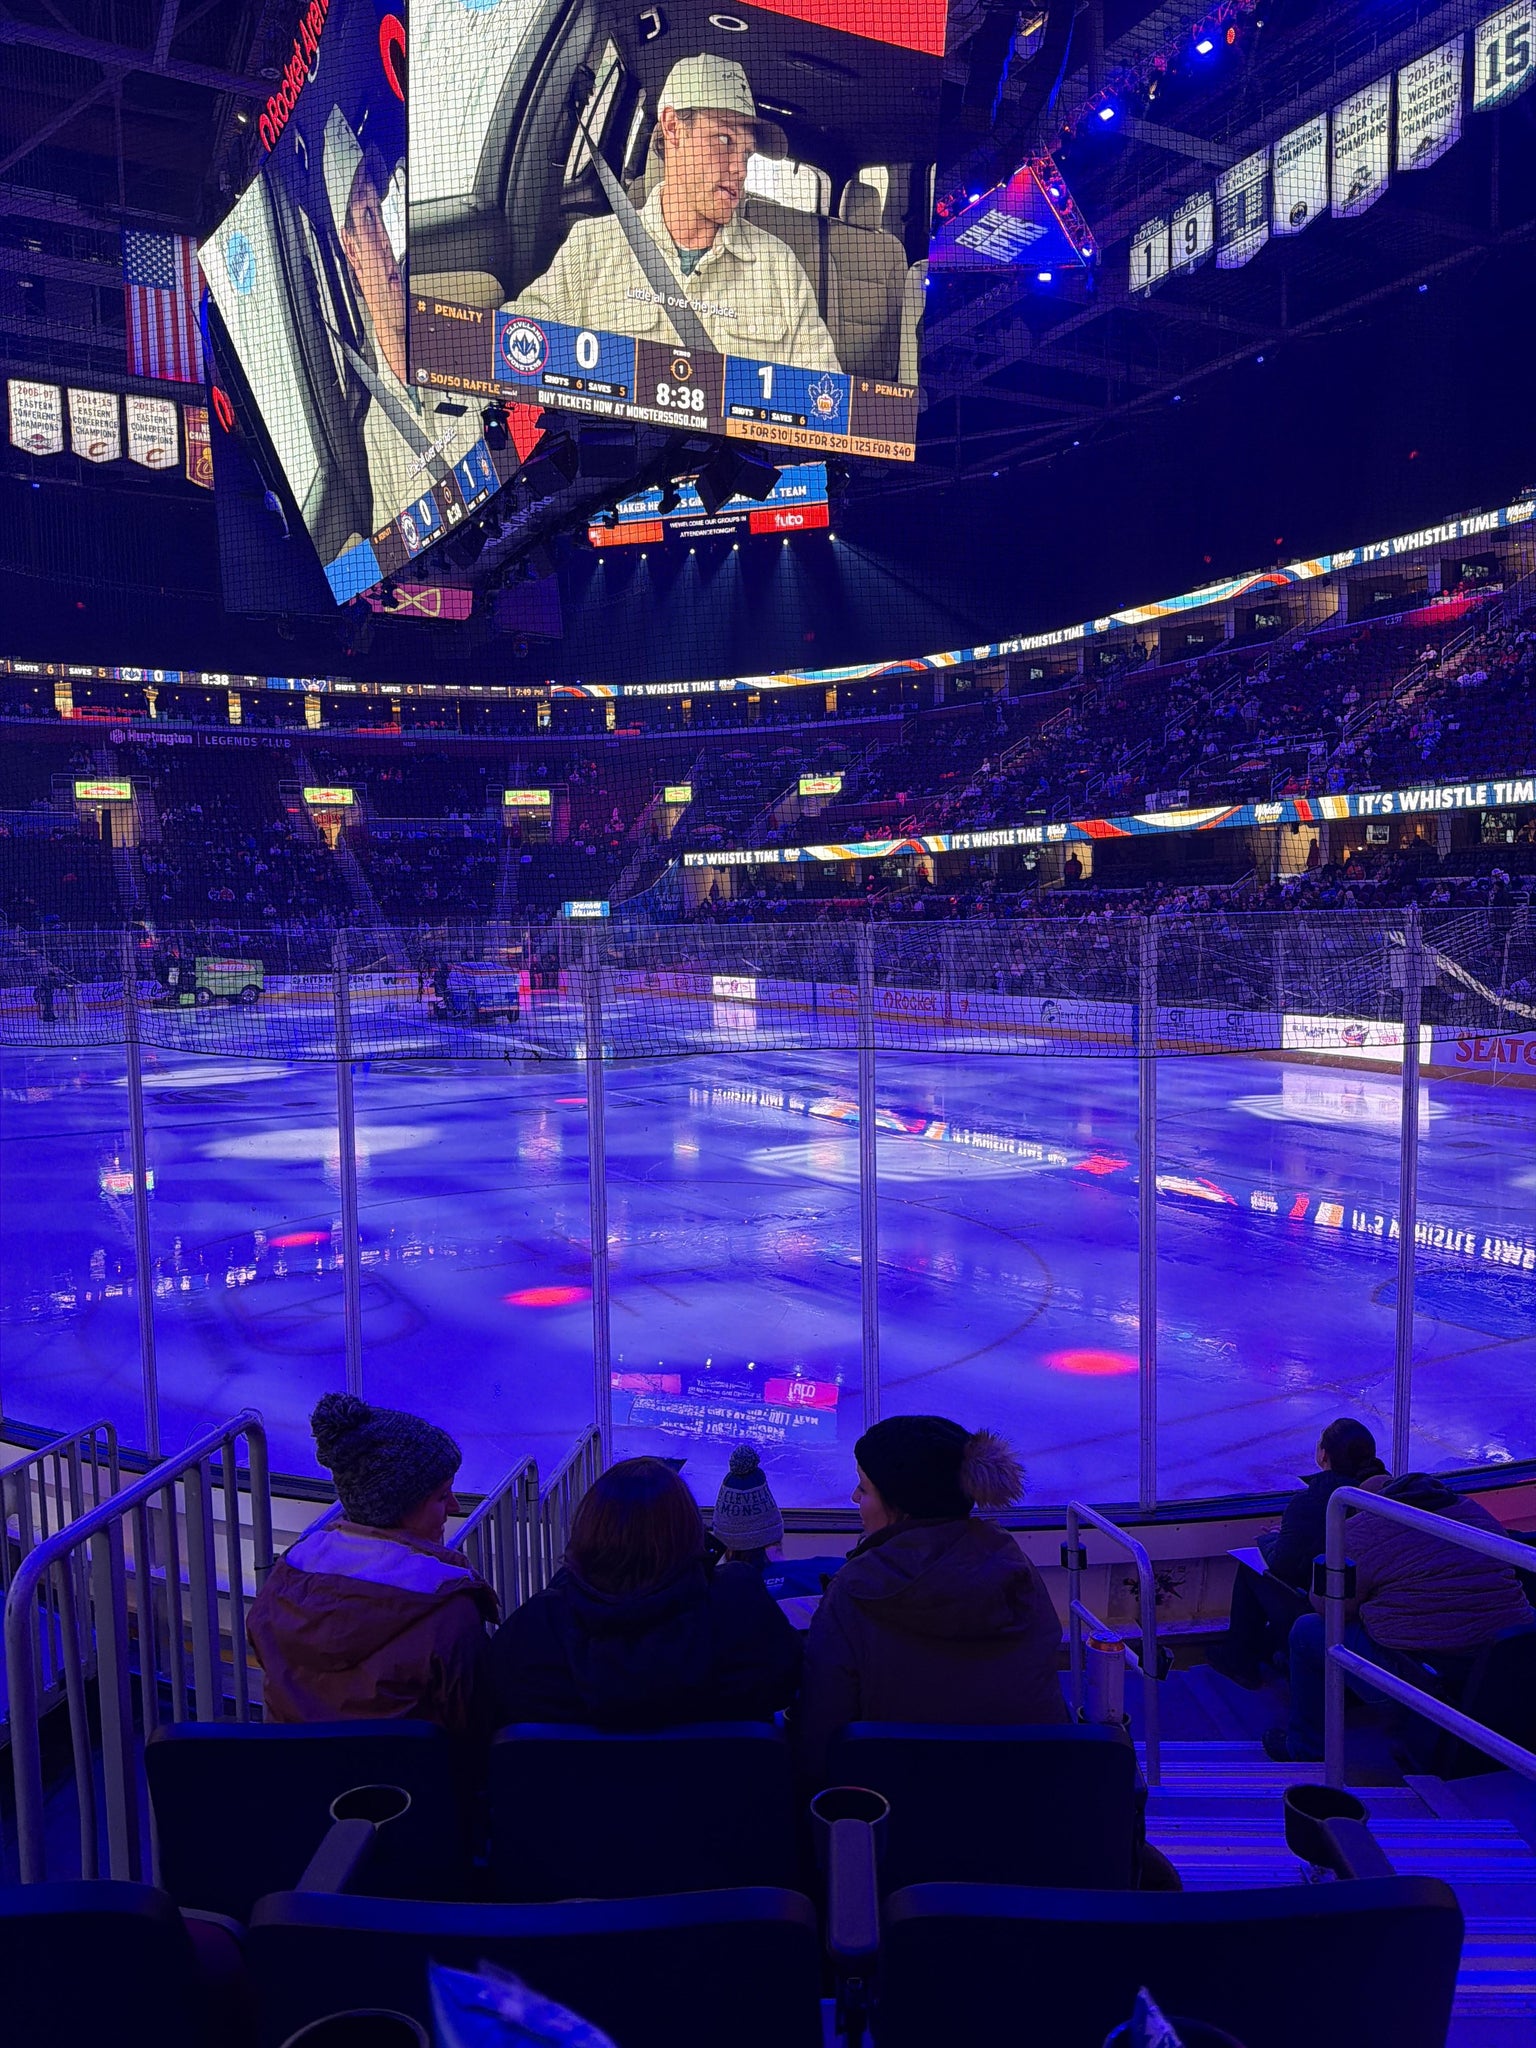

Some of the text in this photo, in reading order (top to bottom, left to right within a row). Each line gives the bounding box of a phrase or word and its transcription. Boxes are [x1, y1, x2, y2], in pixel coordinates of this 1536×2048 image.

[1486, 21, 1531, 90] 15
[1407, 50, 1454, 86] 2015-16
[267, 38, 309, 137] Rocket
[1408, 70, 1452, 104] WESTERN
[1349, 94, 1373, 117] 2016
[1401, 82, 1459, 123] CONFERENCE
[1335, 103, 1388, 144] CALDER CUP
[1403, 100, 1456, 138] CHAMPIONS
[1335, 120, 1387, 159] CHAMPIONS
[1277, 133, 1323, 168] CHAMPIONS
[1173, 191, 1211, 220] GLOVER
[953, 207, 1013, 249] FEAR THE
[1185, 217, 1198, 255] 9
[1144, 242, 1152, 281] 1
[667, 296, 689, 308] over
[690, 299, 707, 312] the
[434, 303, 483, 323] PENALTY
[506, 321, 544, 342] CLEVELAND
[576, 331, 599, 369] 0
[506, 354, 542, 372] MONSTERS
[678, 365, 684, 374] 1
[430, 373, 460, 387] 50/50
[463, 378, 500, 394] RAFFLE
[544, 375, 583, 390] SHOTS 6
[588, 383, 626, 396] SAVES 5
[758, 365, 773, 400] 1
[874, 383, 915, 399] PENALTY
[19, 399, 52, 411] EASTERN
[538, 390, 555, 405] BUY
[557, 393, 592, 411] TICKETS
[614, 402, 626, 416] AT
[656, 383, 705, 412] 8:38
[13, 408, 61, 422] CONFERENCE
[78, 407, 111, 418] EASTERN
[136, 414, 168, 425] EASTERN
[731, 406, 766, 419] SHOTS 6
[771, 412, 806, 426] SAVES 6
[15, 419, 59, 432] CHAMPIONS
[73, 416, 118, 429] CONFERENCE
[131, 423, 175, 435] CONFERENCE
[75, 427, 116, 439] CHAMPIONS
[133, 432, 173, 445] CHAMPIONS
[742, 423, 788, 441] 5 FOR $10
[794, 430, 849, 450] 50 FOR $20
[855, 440, 912, 457] 125 FOR $40
[780, 486, 807, 497] TEAM
[1363, 541, 1390, 561] IT'S
[1393, 523, 1457, 553] WHISTLE
[1460, 512, 1499, 537] TIME
[999, 641, 1018, 655] IT'S
[1020, 632, 1062, 650] WHISTLE
[1064, 624, 1084, 640] TIME
[14, 664, 54, 674] SHOTS 6
[68, 667, 106, 677] SAVES 5
[154, 669, 164, 682] 0
[201, 673, 229, 685] 8:38
[287, 678, 295, 689] 1
[624, 685, 643, 695] IT'S
[646, 682, 689, 694] WHISTLE
[691, 680, 715, 692] TIME
[334, 683, 368, 693] SHOTS 6
[406, 685, 414, 694] 6
[515, 688, 532, 696] 7:49
[127, 730, 192, 746] Huntington
[205, 736, 257, 747] LEGENDS
[1358, 793, 1393, 814] IT'S
[1399, 785, 1487, 811] WHISTLE
[952, 835, 970, 849] IT'S
[971, 830, 1014, 847] WHISTLE
[1017, 827, 1043, 843] TIME
[684, 854, 704, 866] IT'S
[706, 851, 752, 865] WHISTLE
[754, 850, 779, 863] TIME
[894, 991, 937, 1011] Rocket
[764, 1577, 785, 1585] CM
